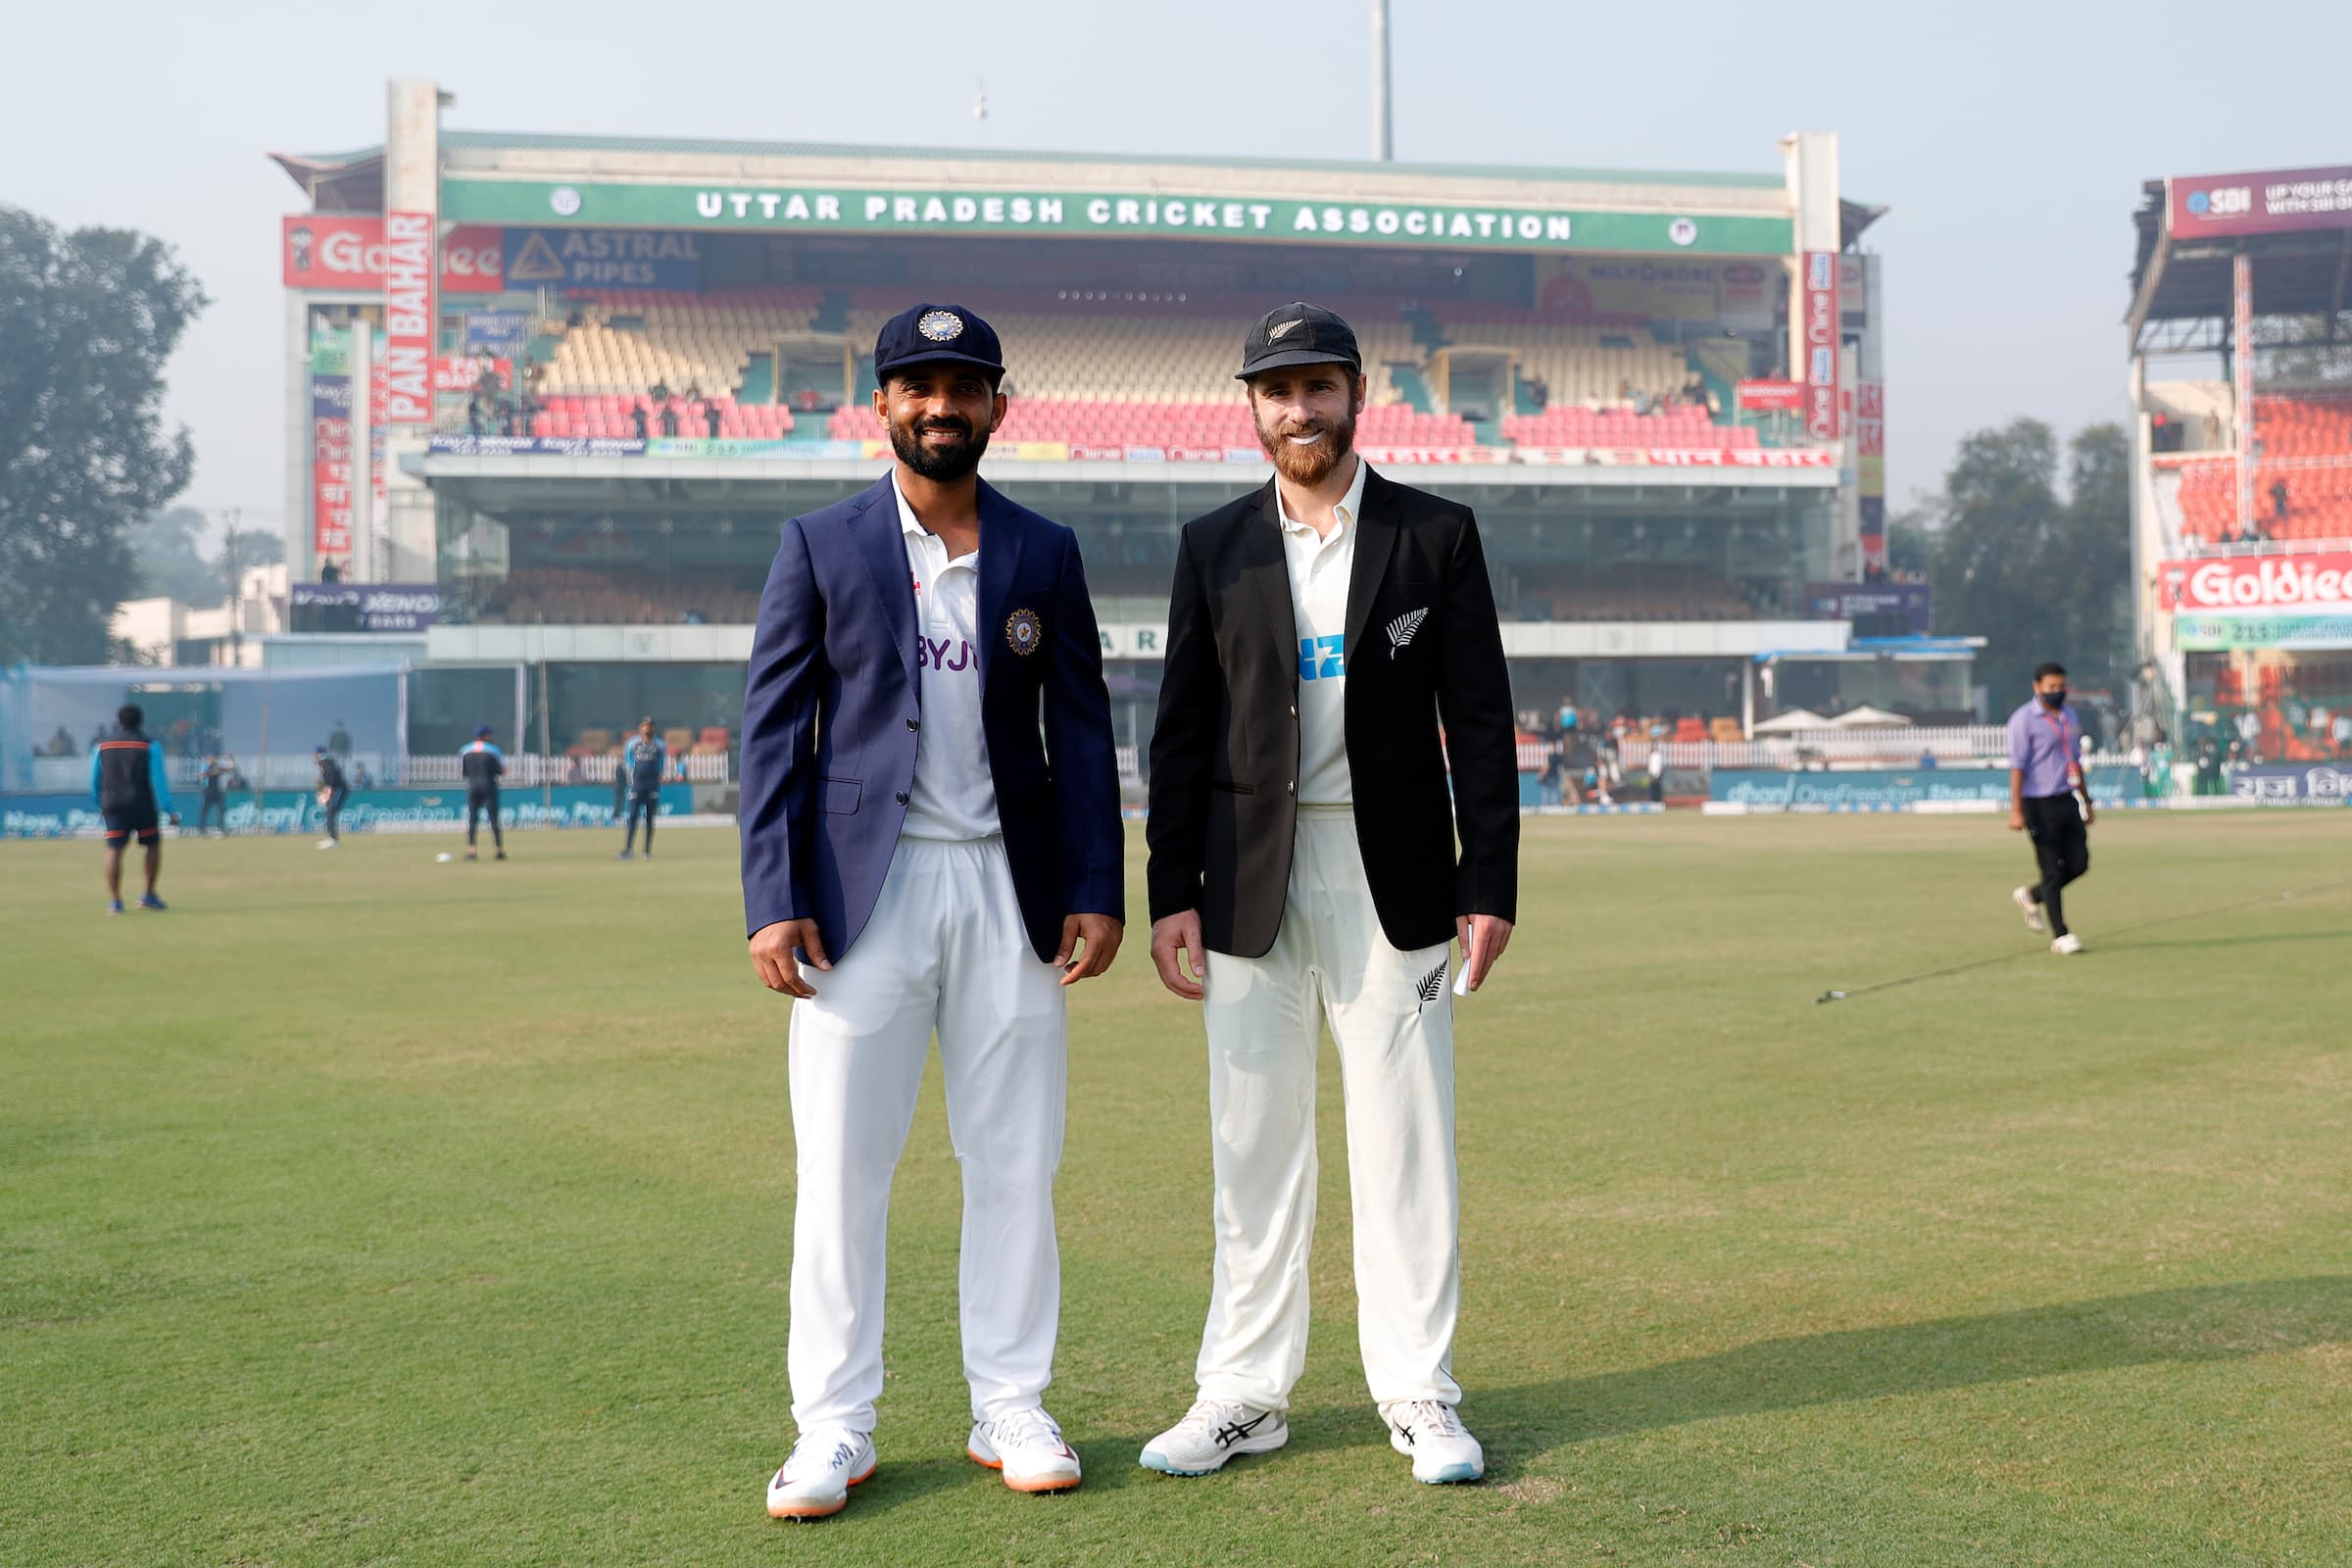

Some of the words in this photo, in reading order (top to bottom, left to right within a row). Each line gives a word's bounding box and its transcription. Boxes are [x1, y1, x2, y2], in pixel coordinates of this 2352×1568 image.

[2210, 186, 2251, 214] SBI
[2266, 182, 2289, 199] UP
[2289, 179, 2334, 197] YOUR
[696, 192, 842, 221] UTTAR
[864, 196, 1064, 224] PRADESH
[1087, 199, 1273, 230] CRICKET
[1294, 207, 1572, 240] ASSOCIATION
[2266, 198, 2307, 215] WITH
[2309, 197, 2333, 213] SBI
[564, 231, 700, 260] ASTRAL
[392, 214, 428, 337] BAHAR
[573, 261, 656, 284] PIPES
[392, 346, 428, 419] PAN
[918, 635, 979, 671] BYJ
[67, 808, 102, 827] Pa
[309, 803, 455, 824] OeFreedom
